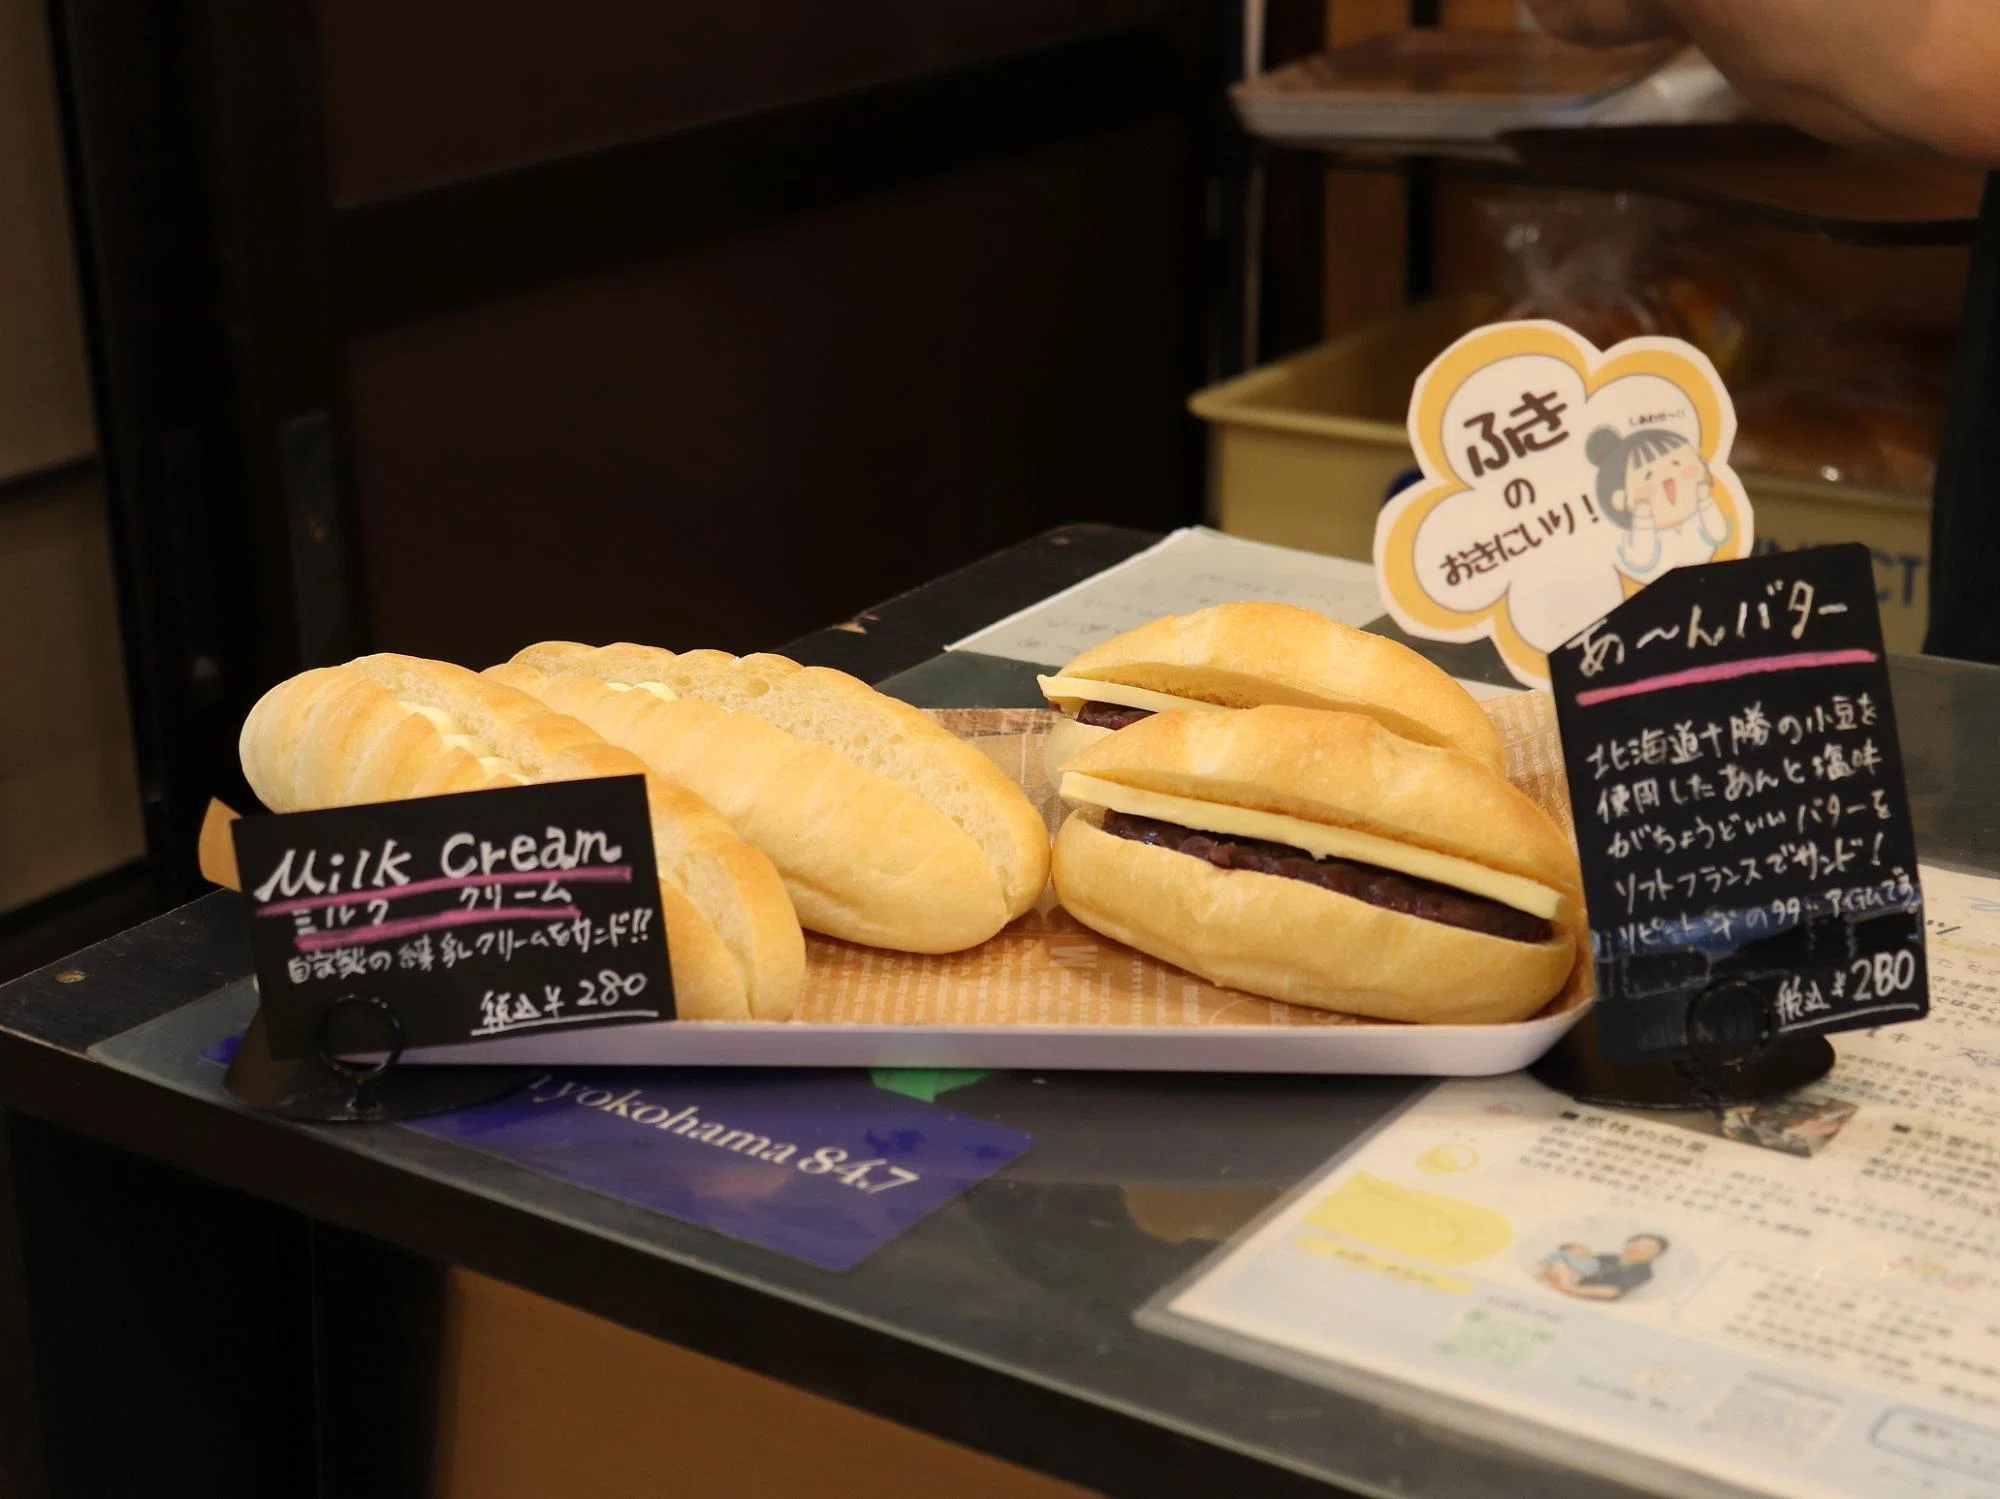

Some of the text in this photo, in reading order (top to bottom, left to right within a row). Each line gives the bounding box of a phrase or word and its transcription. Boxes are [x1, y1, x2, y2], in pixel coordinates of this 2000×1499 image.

[1462, 391, 1570, 478] ふき
[1503, 477, 1536, 510] の
[254, 826, 622, 903] Milk Cream
[293, 880, 573, 936] ミルク クリーム
[534, 1080, 921, 1195] yokohama 84.7
